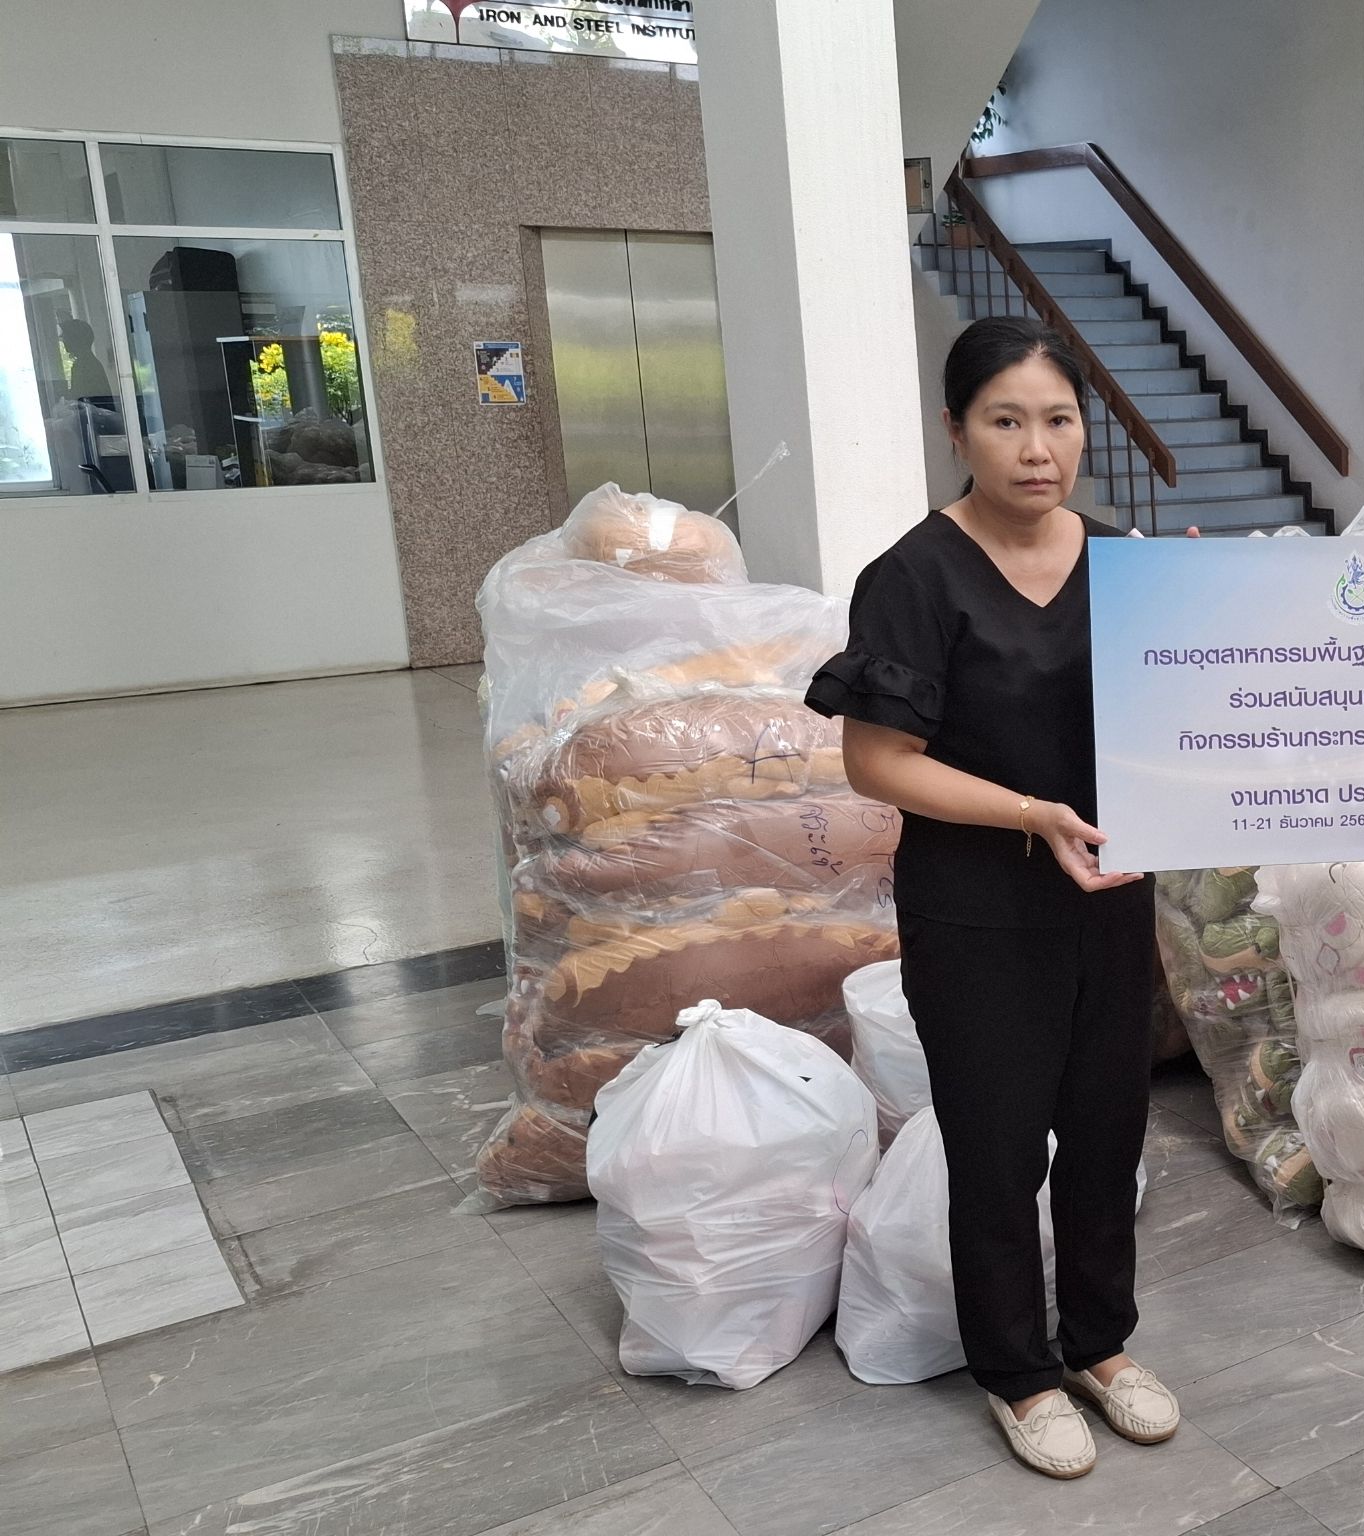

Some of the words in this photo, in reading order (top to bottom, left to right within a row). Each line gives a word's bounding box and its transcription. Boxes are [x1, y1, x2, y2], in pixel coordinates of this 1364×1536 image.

[479, 8, 522, 24] IRON
[532, 13, 567, 28] AND
[573, 17, 624, 34] STEEL
[1230, 787, 1329, 807] งานกาชาด
[1232, 817, 1271, 831] 11-21
[1279, 815, 1334, 829] ธันวาคม
